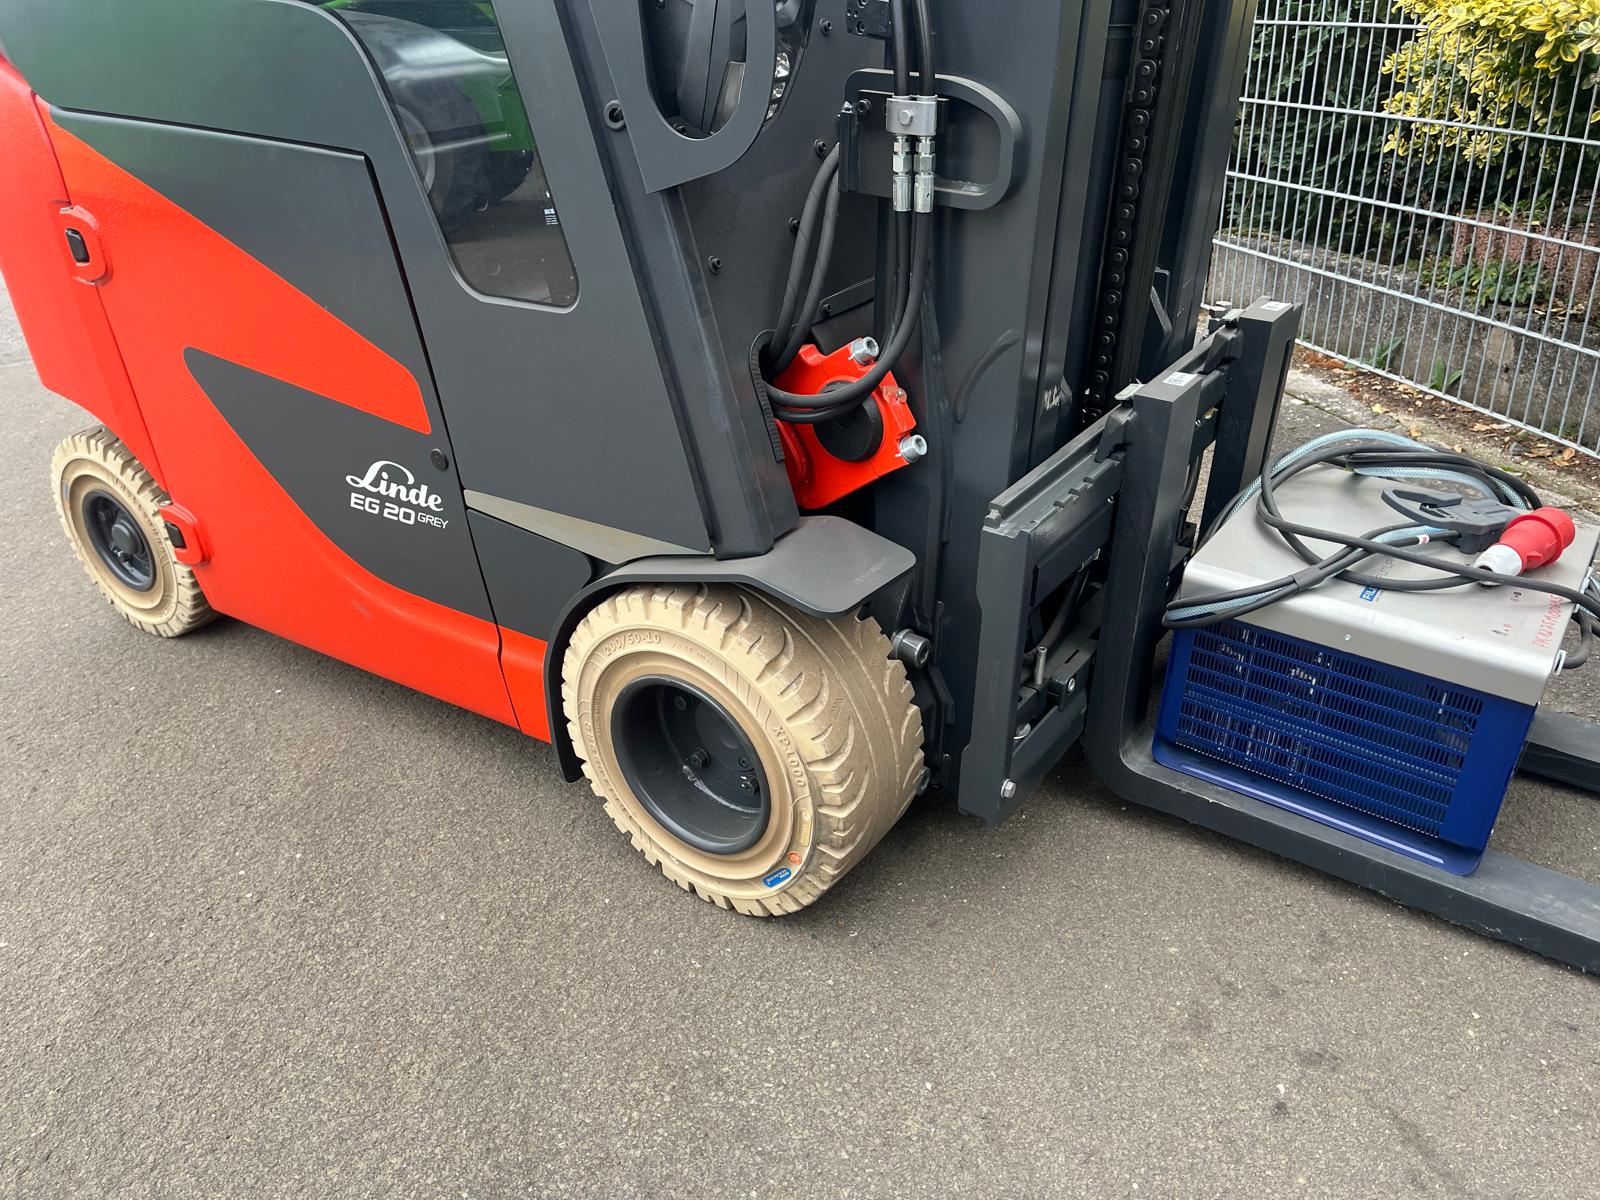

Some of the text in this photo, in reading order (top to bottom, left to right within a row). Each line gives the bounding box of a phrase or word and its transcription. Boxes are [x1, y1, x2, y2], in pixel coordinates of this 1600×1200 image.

[345, 460, 443, 511] Linde
[350, 492, 449, 529] EG 20 GREY
[603, 631, 661, 656] 200/50-10
